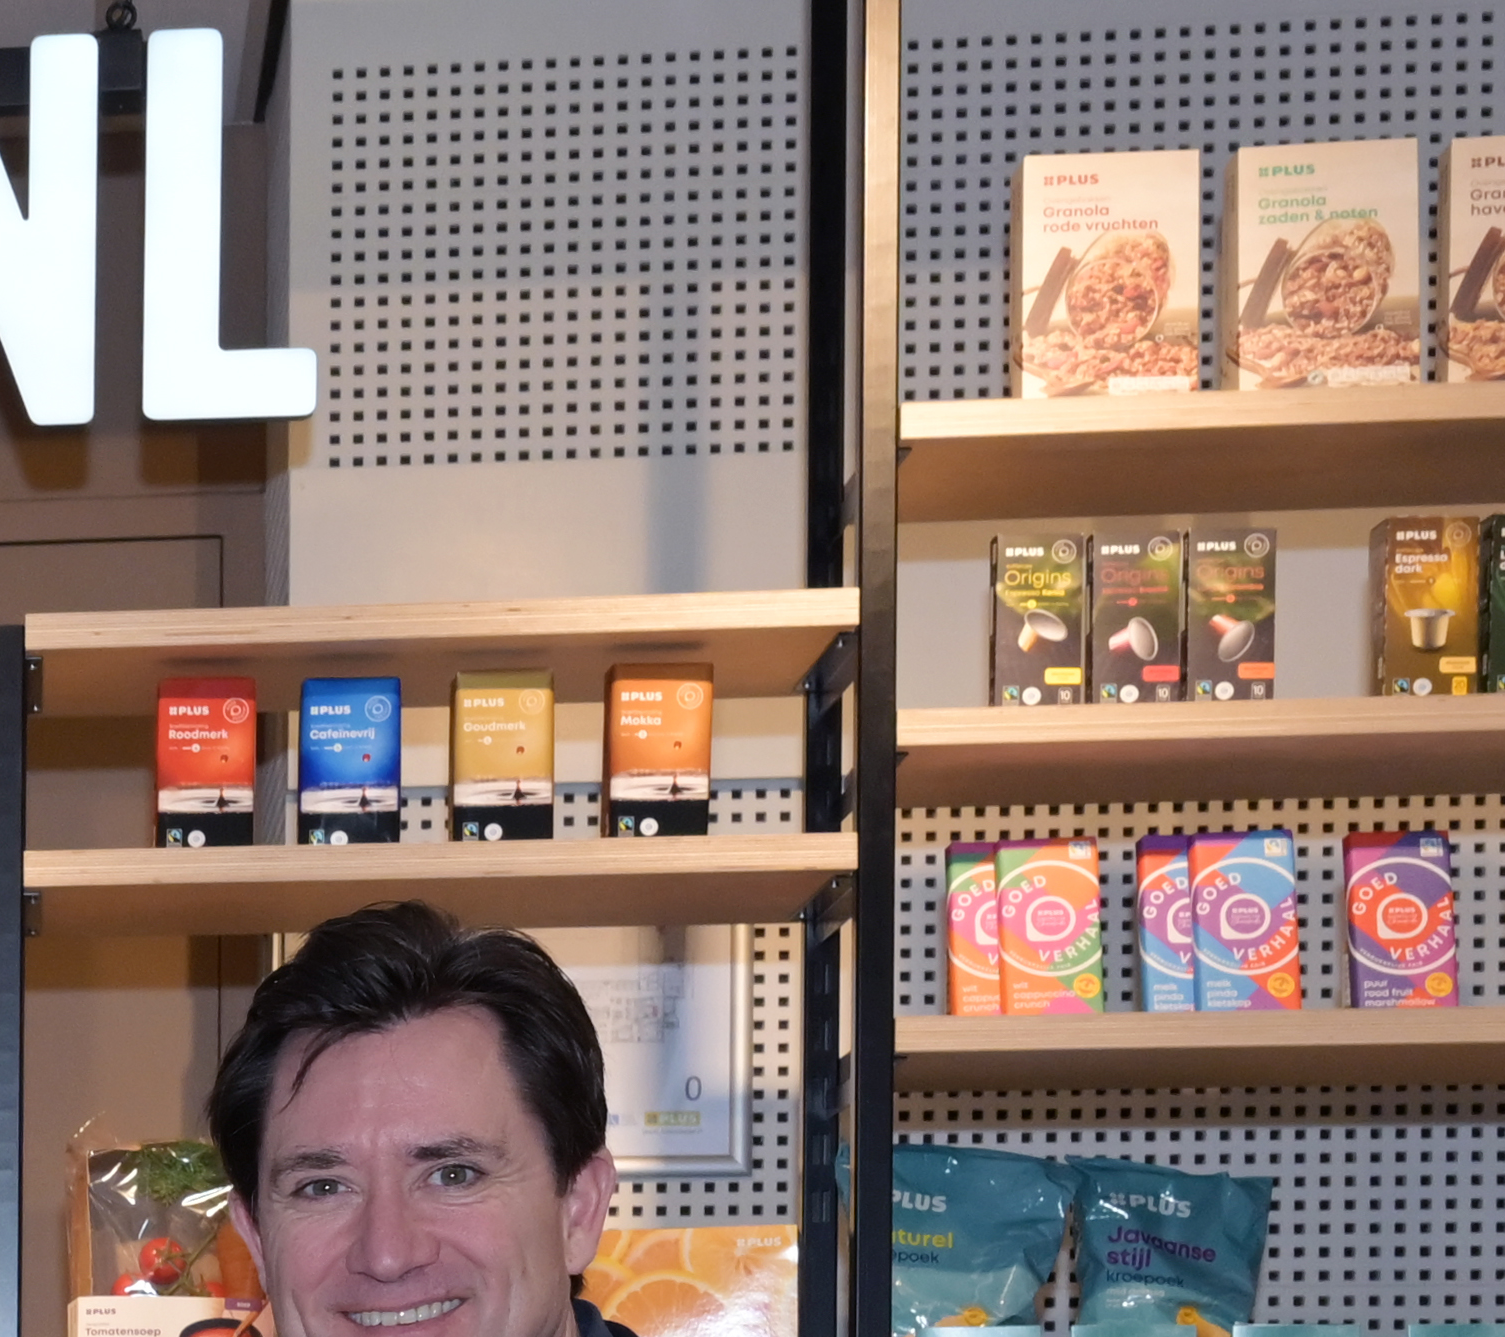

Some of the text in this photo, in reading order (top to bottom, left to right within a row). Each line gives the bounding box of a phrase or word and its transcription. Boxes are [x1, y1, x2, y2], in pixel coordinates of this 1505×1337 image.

[1273, 164, 1315, 176] PLUS
[1057, 174, 1099, 185] PLUS
[1258, 195, 1327, 209] Granola
[1043, 205, 1110, 218] Granola
[1258, 206, 1379, 225] zaden & noten
[1043, 217, 1158, 232] rode vruchten
[1406, 531, 1437, 540] PLUS
[1015, 547, 1044, 557] PLUS
[1110, 545, 1140, 554] PLUS
[1206, 542, 1236, 551] PLUS
[1395, 553, 1448, 563] Espresso
[1395, 563, 1422, 574] dark
[1004, 570, 1072, 588] Origins
[1060, 691, 1070, 700] 10
[1158, 688, 1168, 698] 10
[1253, 685, 1264, 696] 10
[631, 692, 663, 701] PLUS
[474, 698, 504, 707] PLUS
[178, 706, 209, 715] PLUS
[320, 706, 351, 715] PLUS
[464, 721, 525, 732] Goudmerk
[621, 716, 661, 726] Mokka
[169, 729, 228, 739] Roodmerk
[1002, 875, 1046, 918] GOED
[1196, 873, 1242, 916] GOED
[1353, 873, 1398, 915] GOED
[952, 879, 997, 922] GOED
[1038, 899, 1100, 963] VERHAAL
[1233, 897, 1296, 963] VERHAAL
[1389, 897, 1454, 962] VERHAAL
[685, 1076, 702, 1101] 0
[1130, 1195, 1191, 1218] PLUS
[748, 1237, 781, 1246] PLUS
[1107, 1225, 1216, 1263] Javaanse
[1106, 1249, 1151, 1269] stijl
[1106, 1270, 1184, 1287] kroepoek
[86, 1328, 161, 1337] Tomatensoep
